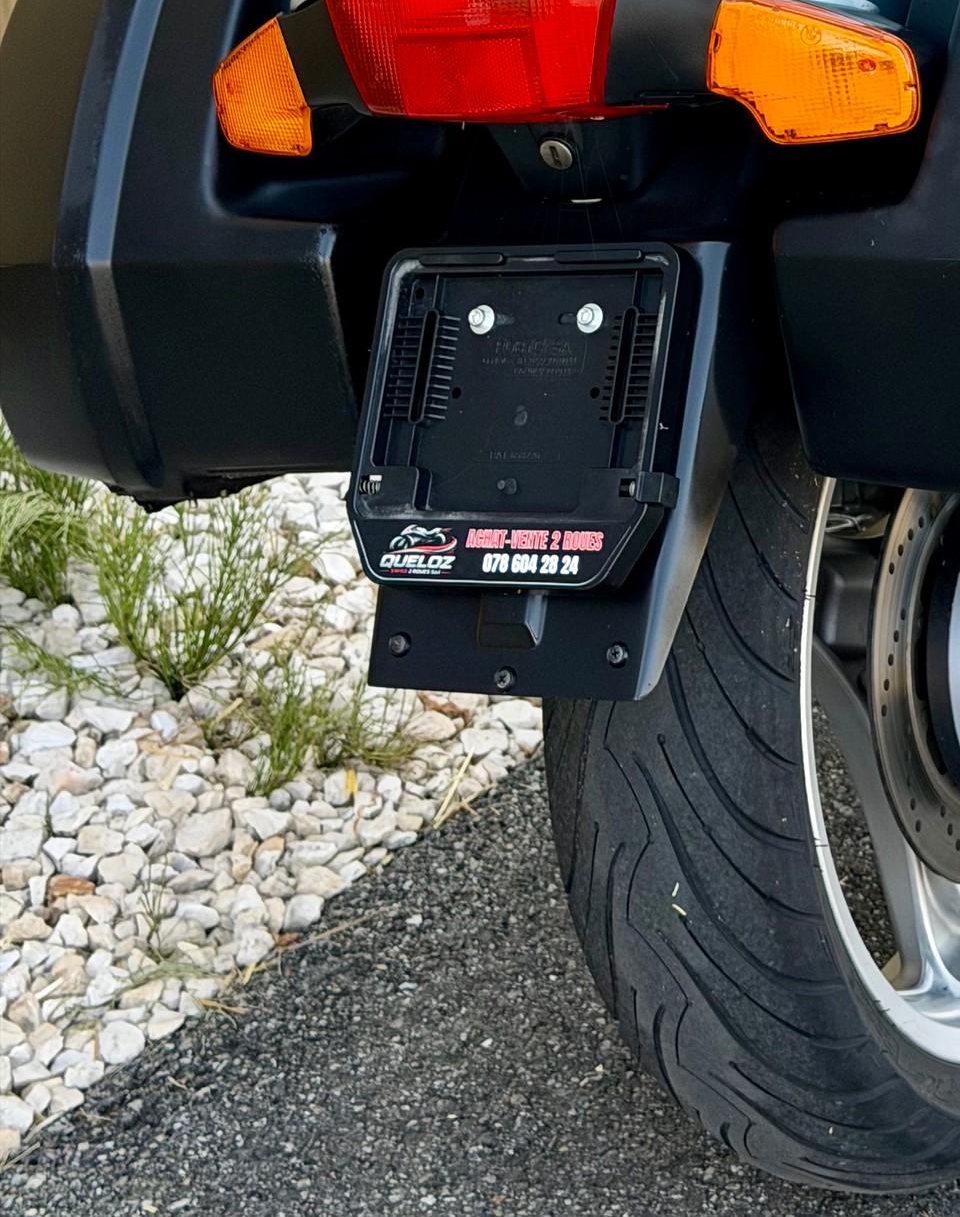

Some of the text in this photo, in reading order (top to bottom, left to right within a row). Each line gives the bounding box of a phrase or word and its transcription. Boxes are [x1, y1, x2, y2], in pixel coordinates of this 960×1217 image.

[465, 528, 604, 551] ACHAT-VENTE 2 ROUES
[379, 554, 456, 570] QUELOZ
[482, 552, 580, 575] 078 604 28 24
